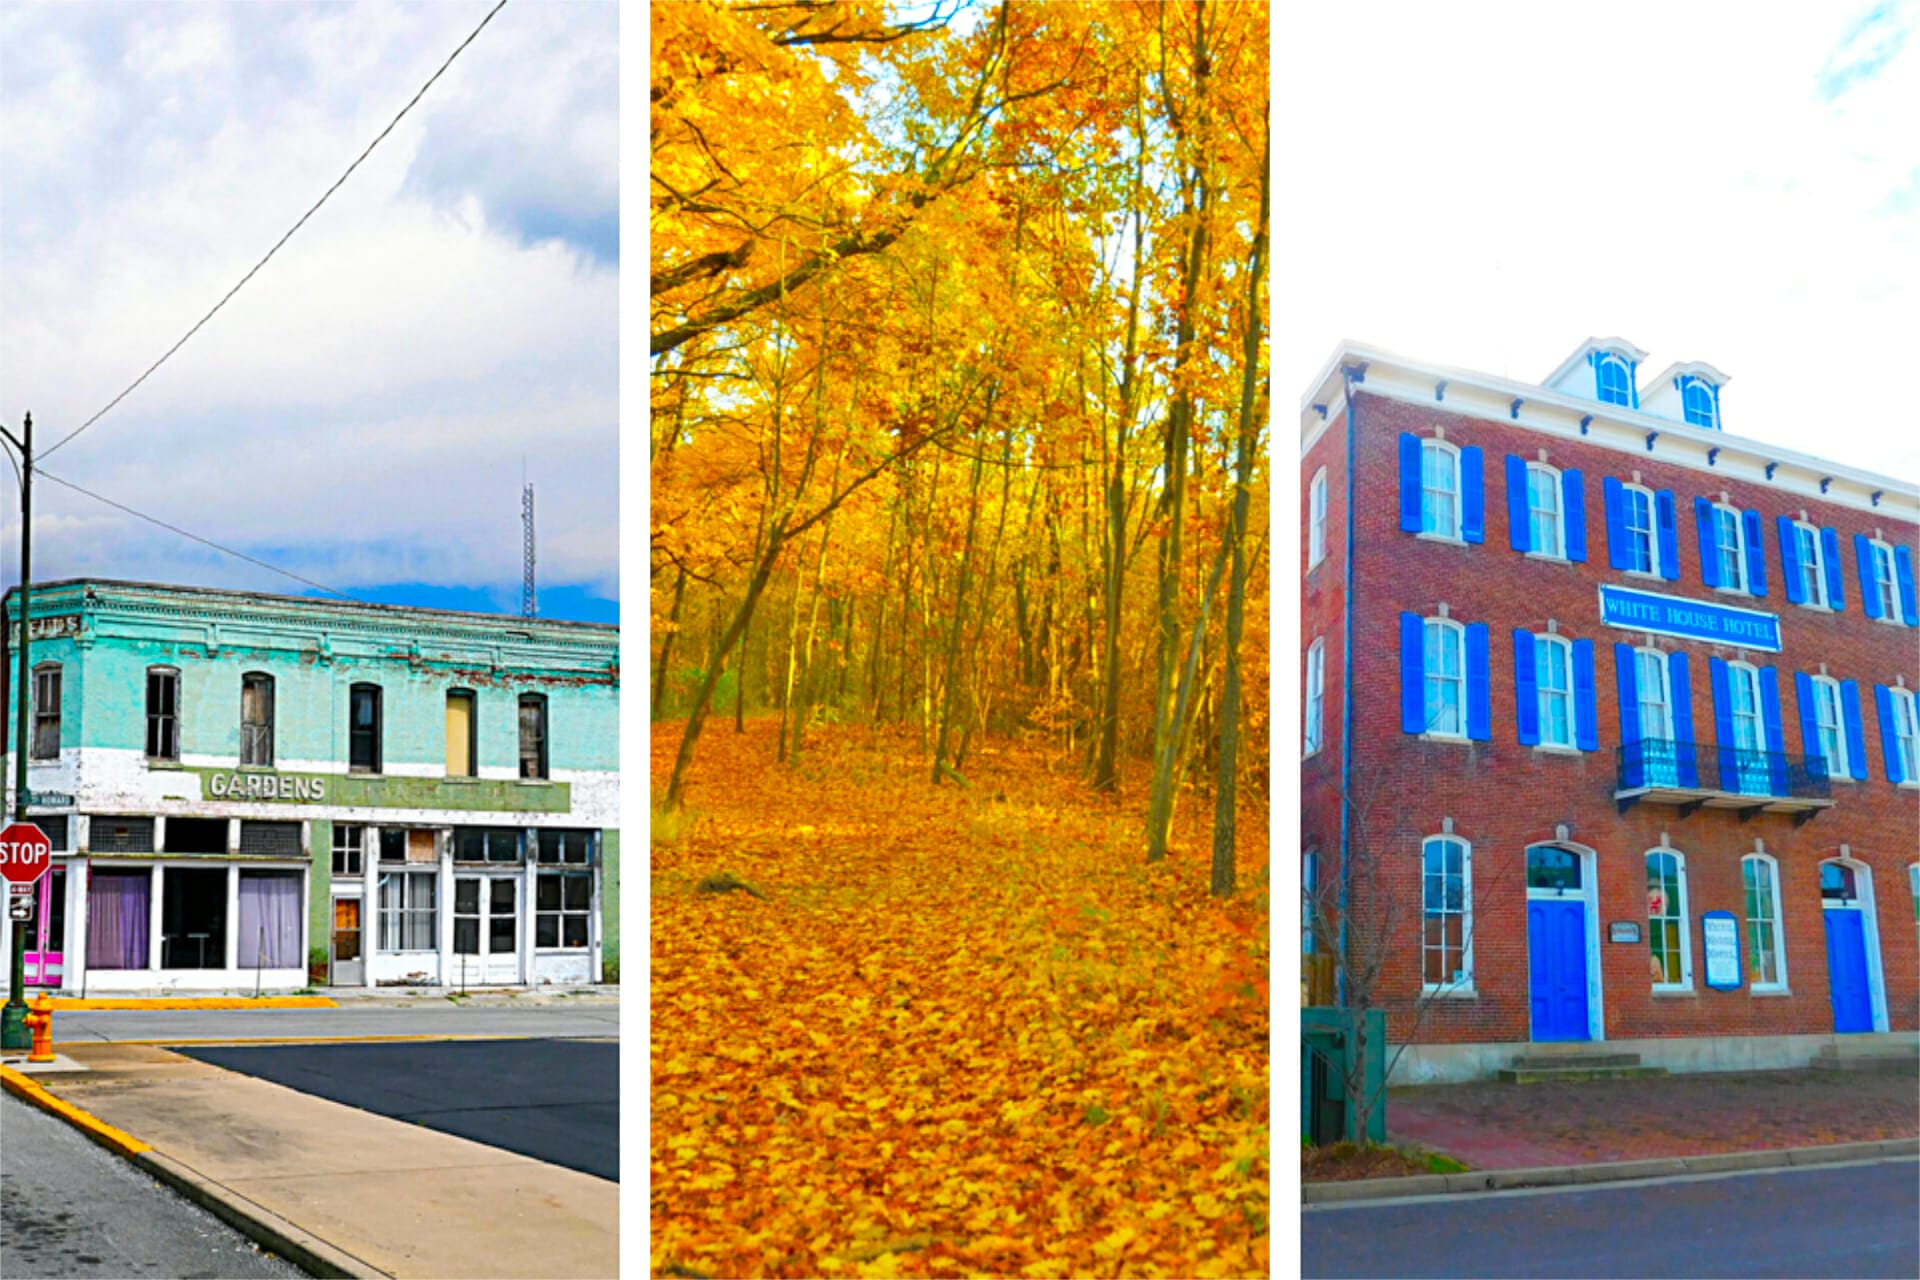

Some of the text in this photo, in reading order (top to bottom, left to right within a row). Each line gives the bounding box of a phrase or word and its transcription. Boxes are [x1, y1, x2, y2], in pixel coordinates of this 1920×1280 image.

[1606, 597, 1775, 641] WHITE HOUSE HOTEL
[210, 772, 326, 800] GARDENS
[0, 842, 47, 864] STOP
